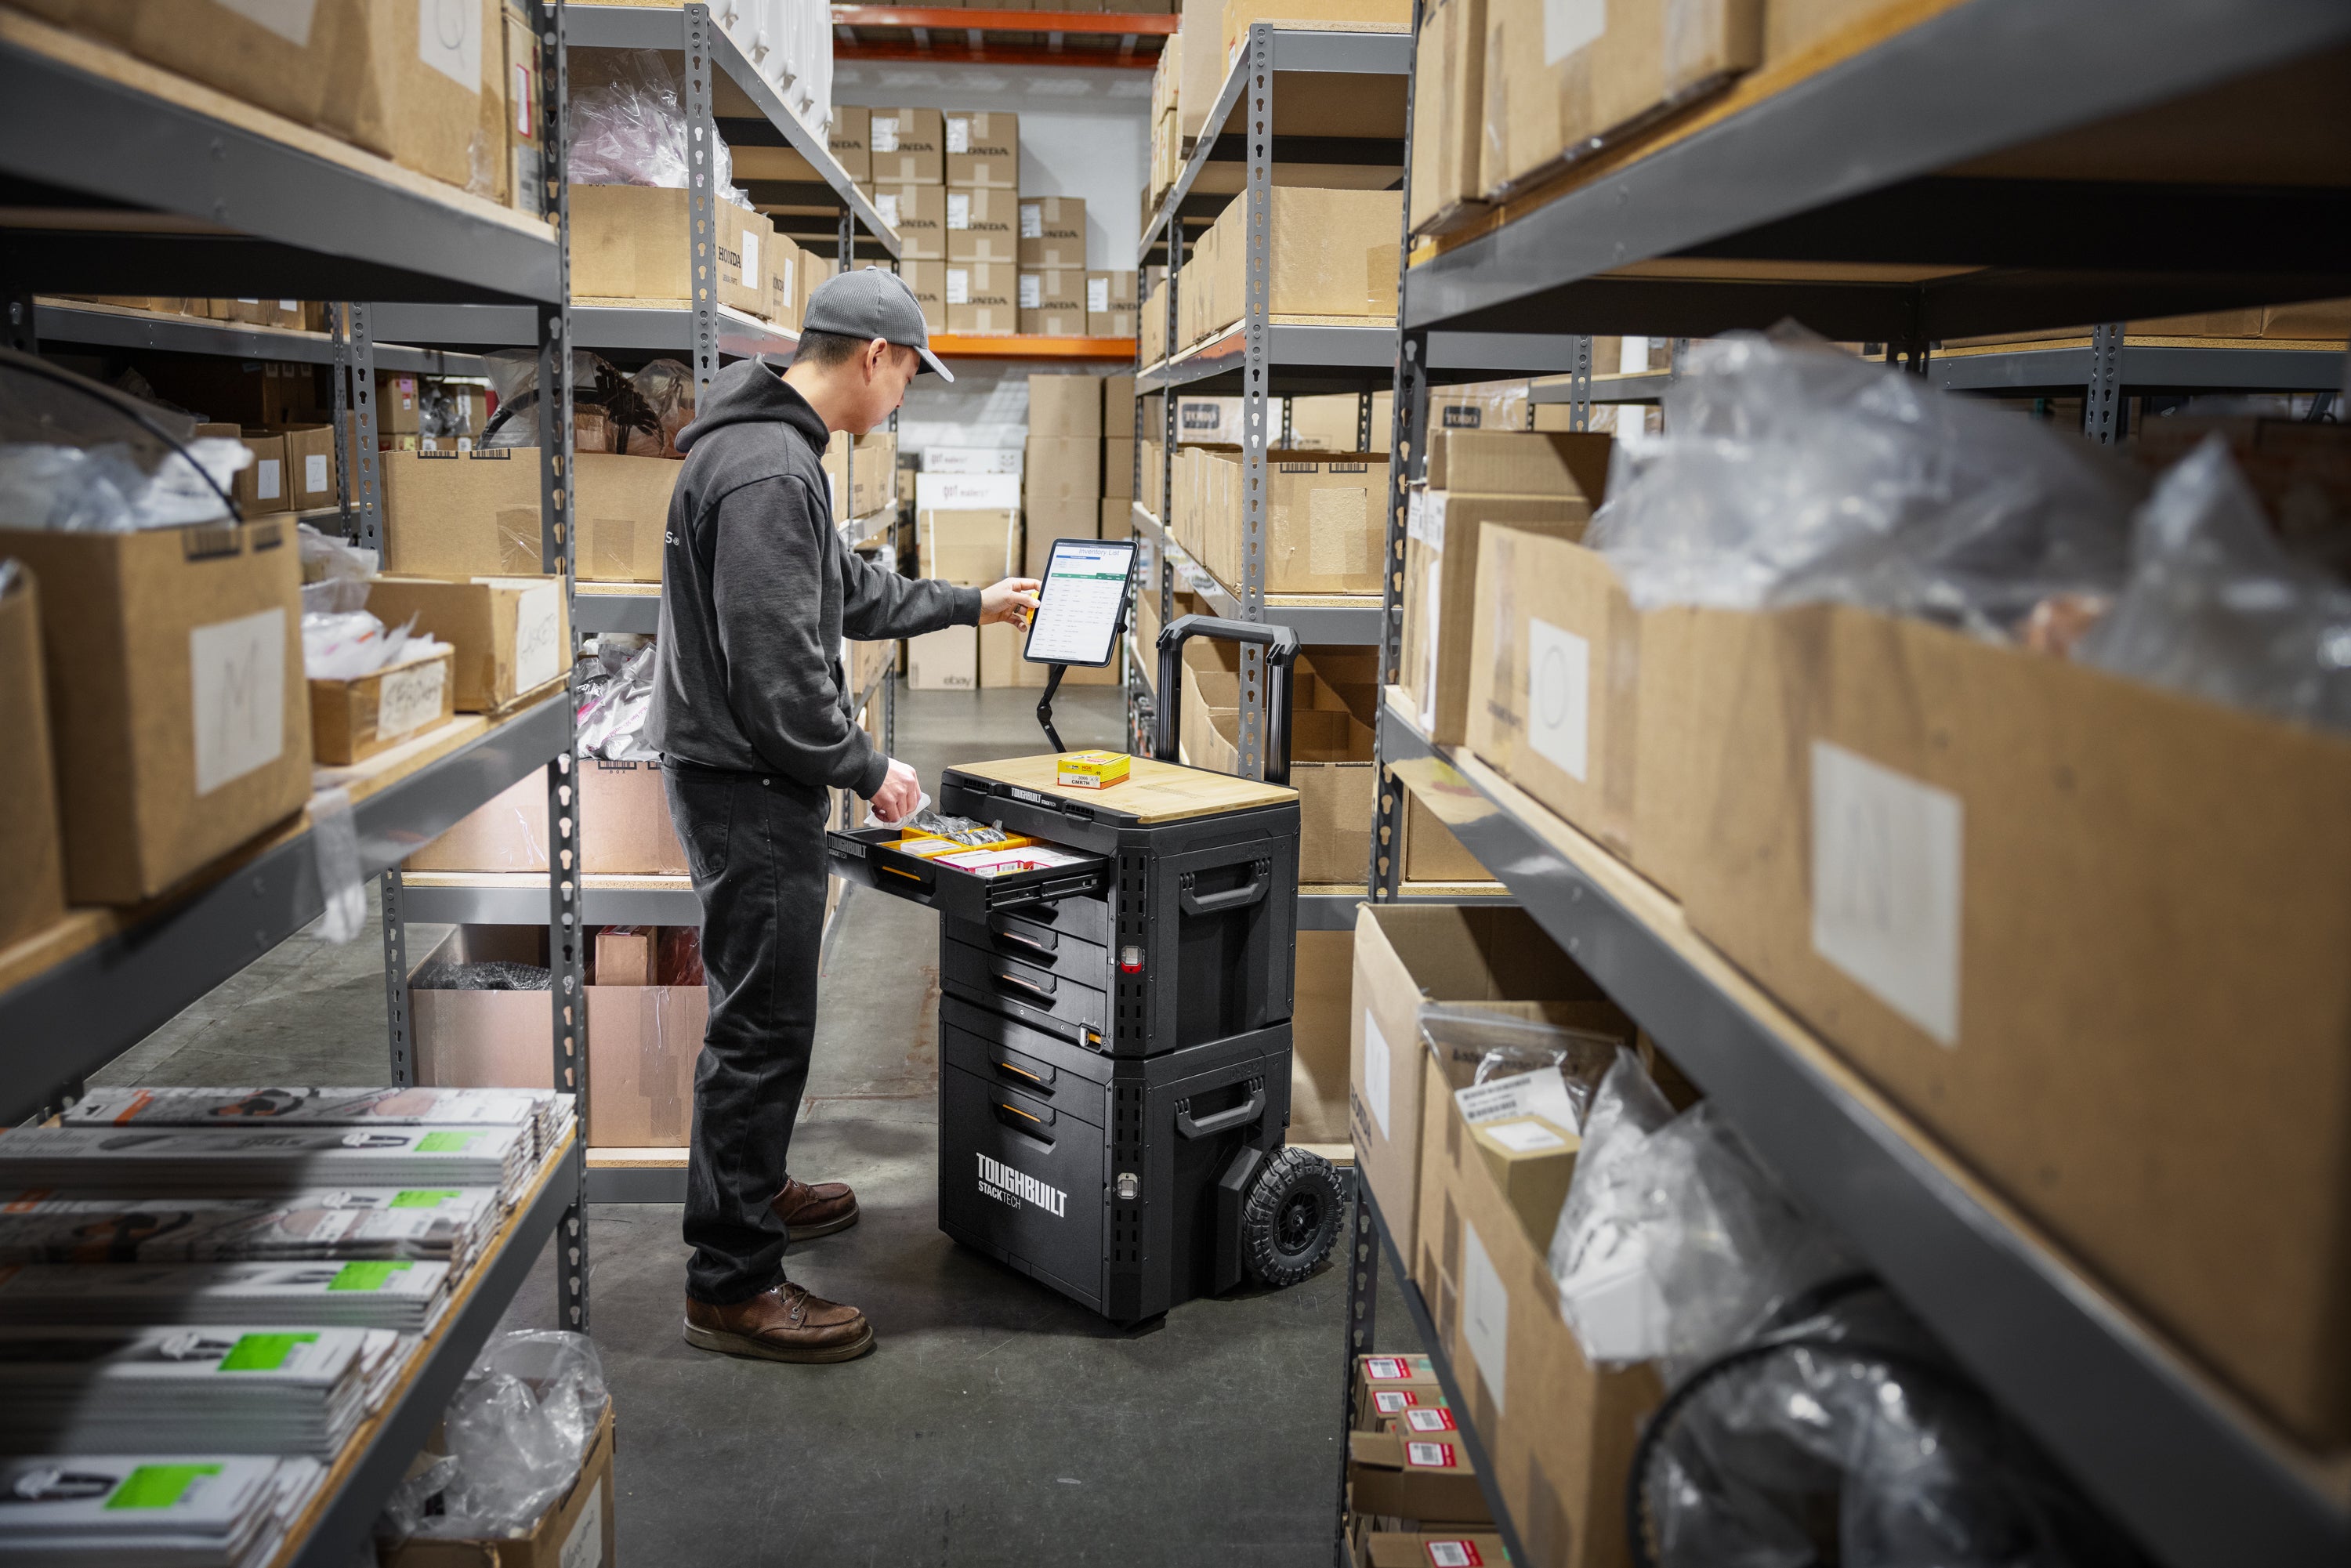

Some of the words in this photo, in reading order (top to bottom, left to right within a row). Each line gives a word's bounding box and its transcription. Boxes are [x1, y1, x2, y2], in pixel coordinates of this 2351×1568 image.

[967, 147, 1009, 156] ONDA
[968, 222, 1009, 231] ONDA
[1041, 230, 1079, 239] ONDA
[718, 245, 741, 268] HONDA
[966, 297, 1008, 306] ONDA
[1040, 301, 1079, 310] ONDA
[944, 675, 973, 687] ebay
[1011, 787, 1042, 804] TOUGHBUILT
[828, 835, 867, 859] TOUGHBUILT
[976, 1151, 1067, 1219] TOUGHBUILT
[978, 1180, 1021, 1210] STACKTECH
